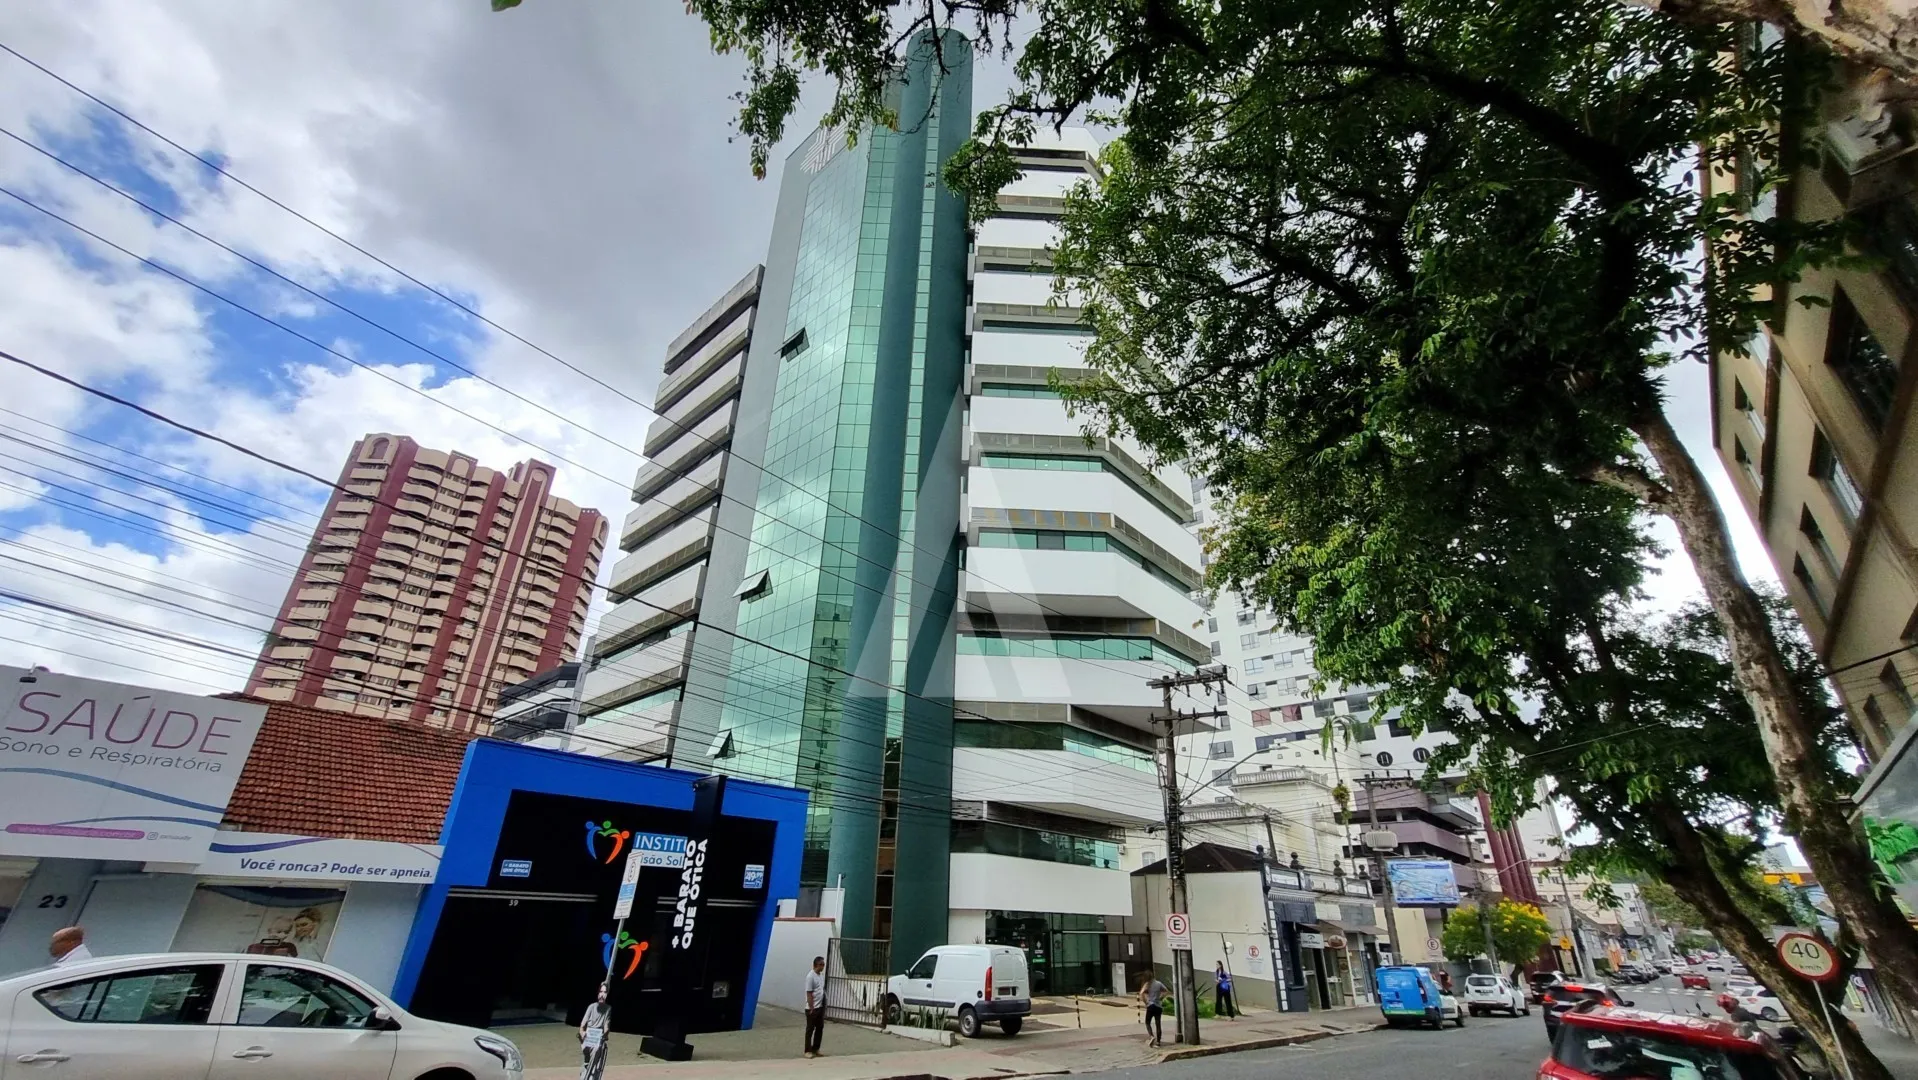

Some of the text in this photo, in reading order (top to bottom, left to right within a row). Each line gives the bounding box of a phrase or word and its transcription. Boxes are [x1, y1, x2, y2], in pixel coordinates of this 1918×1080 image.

[5, 691, 242, 756] SAÚDE
[0, 736, 222, 773] Sono e Respiratória
[240, 858, 432, 879] Você ronca? Pode ser apneia.
[673, 840, 696, 927] BARATO
[37, 895, 68, 908] 23
[682, 906, 697, 949] QUE
[1173, 919, 1181, 931] E
[1791, 942, 1820, 959] 40
